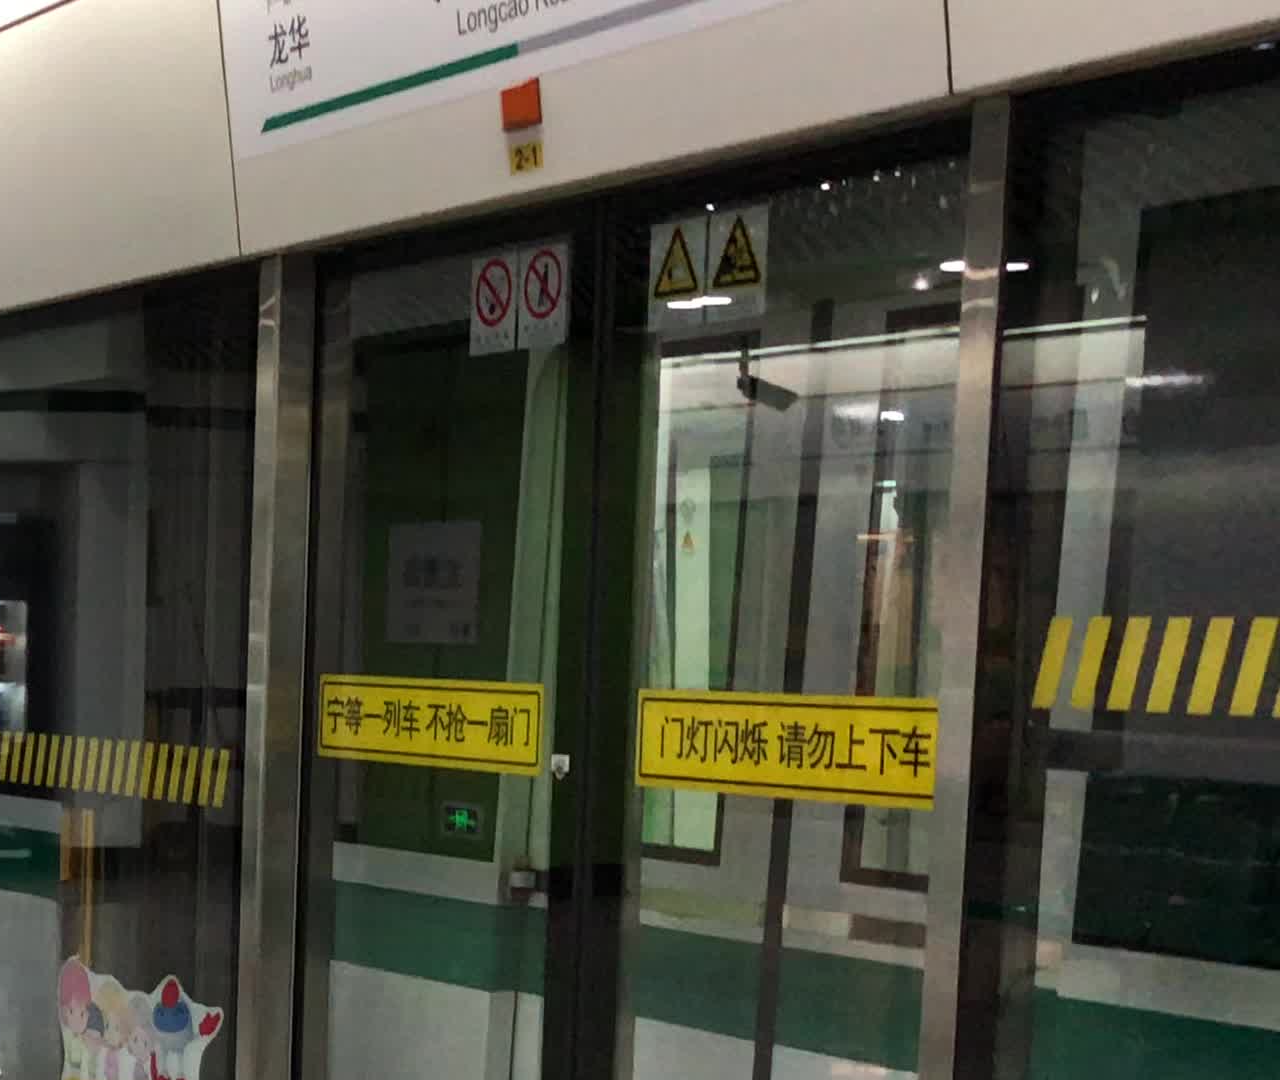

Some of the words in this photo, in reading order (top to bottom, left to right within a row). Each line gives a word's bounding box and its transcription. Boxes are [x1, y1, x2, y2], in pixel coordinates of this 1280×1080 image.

[268, 15, 310, 68] 龙华
[514, 146, 539, 171] 2-1
[326, 697, 421, 741] 宁等一列车
[426, 702, 531, 748] 不抢一扇门
[659, 716, 768, 767] 门灯闪烁
[776, 723, 932, 778] 请勿上下车
